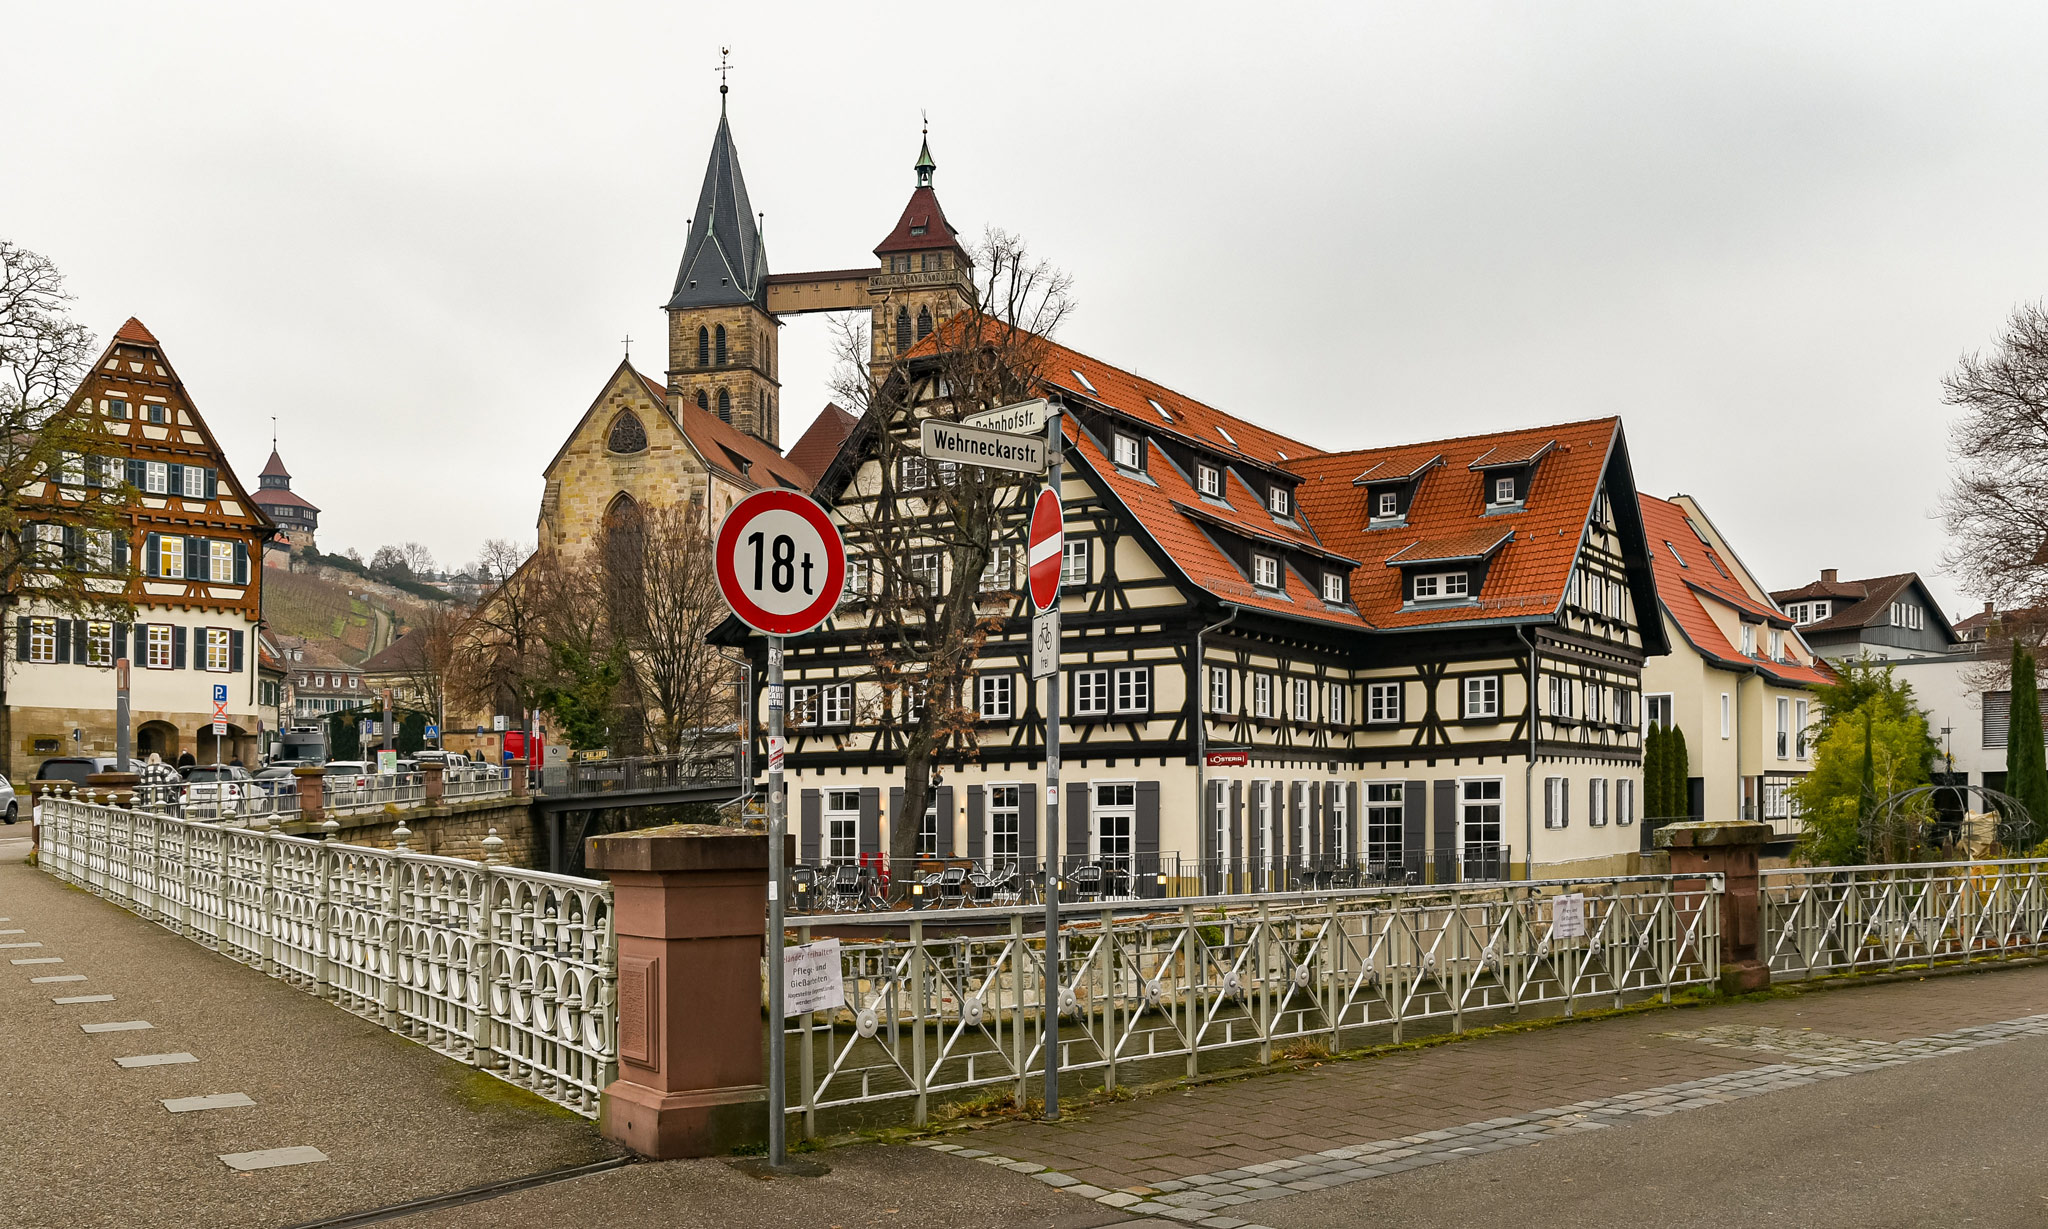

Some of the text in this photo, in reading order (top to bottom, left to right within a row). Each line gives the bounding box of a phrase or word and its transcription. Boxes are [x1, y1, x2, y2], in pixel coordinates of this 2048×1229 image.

[934, 429, 1037, 463] Wehrneckarstr.
[1041, 655, 1049, 669] frei
[215, 686, 223, 699] P
